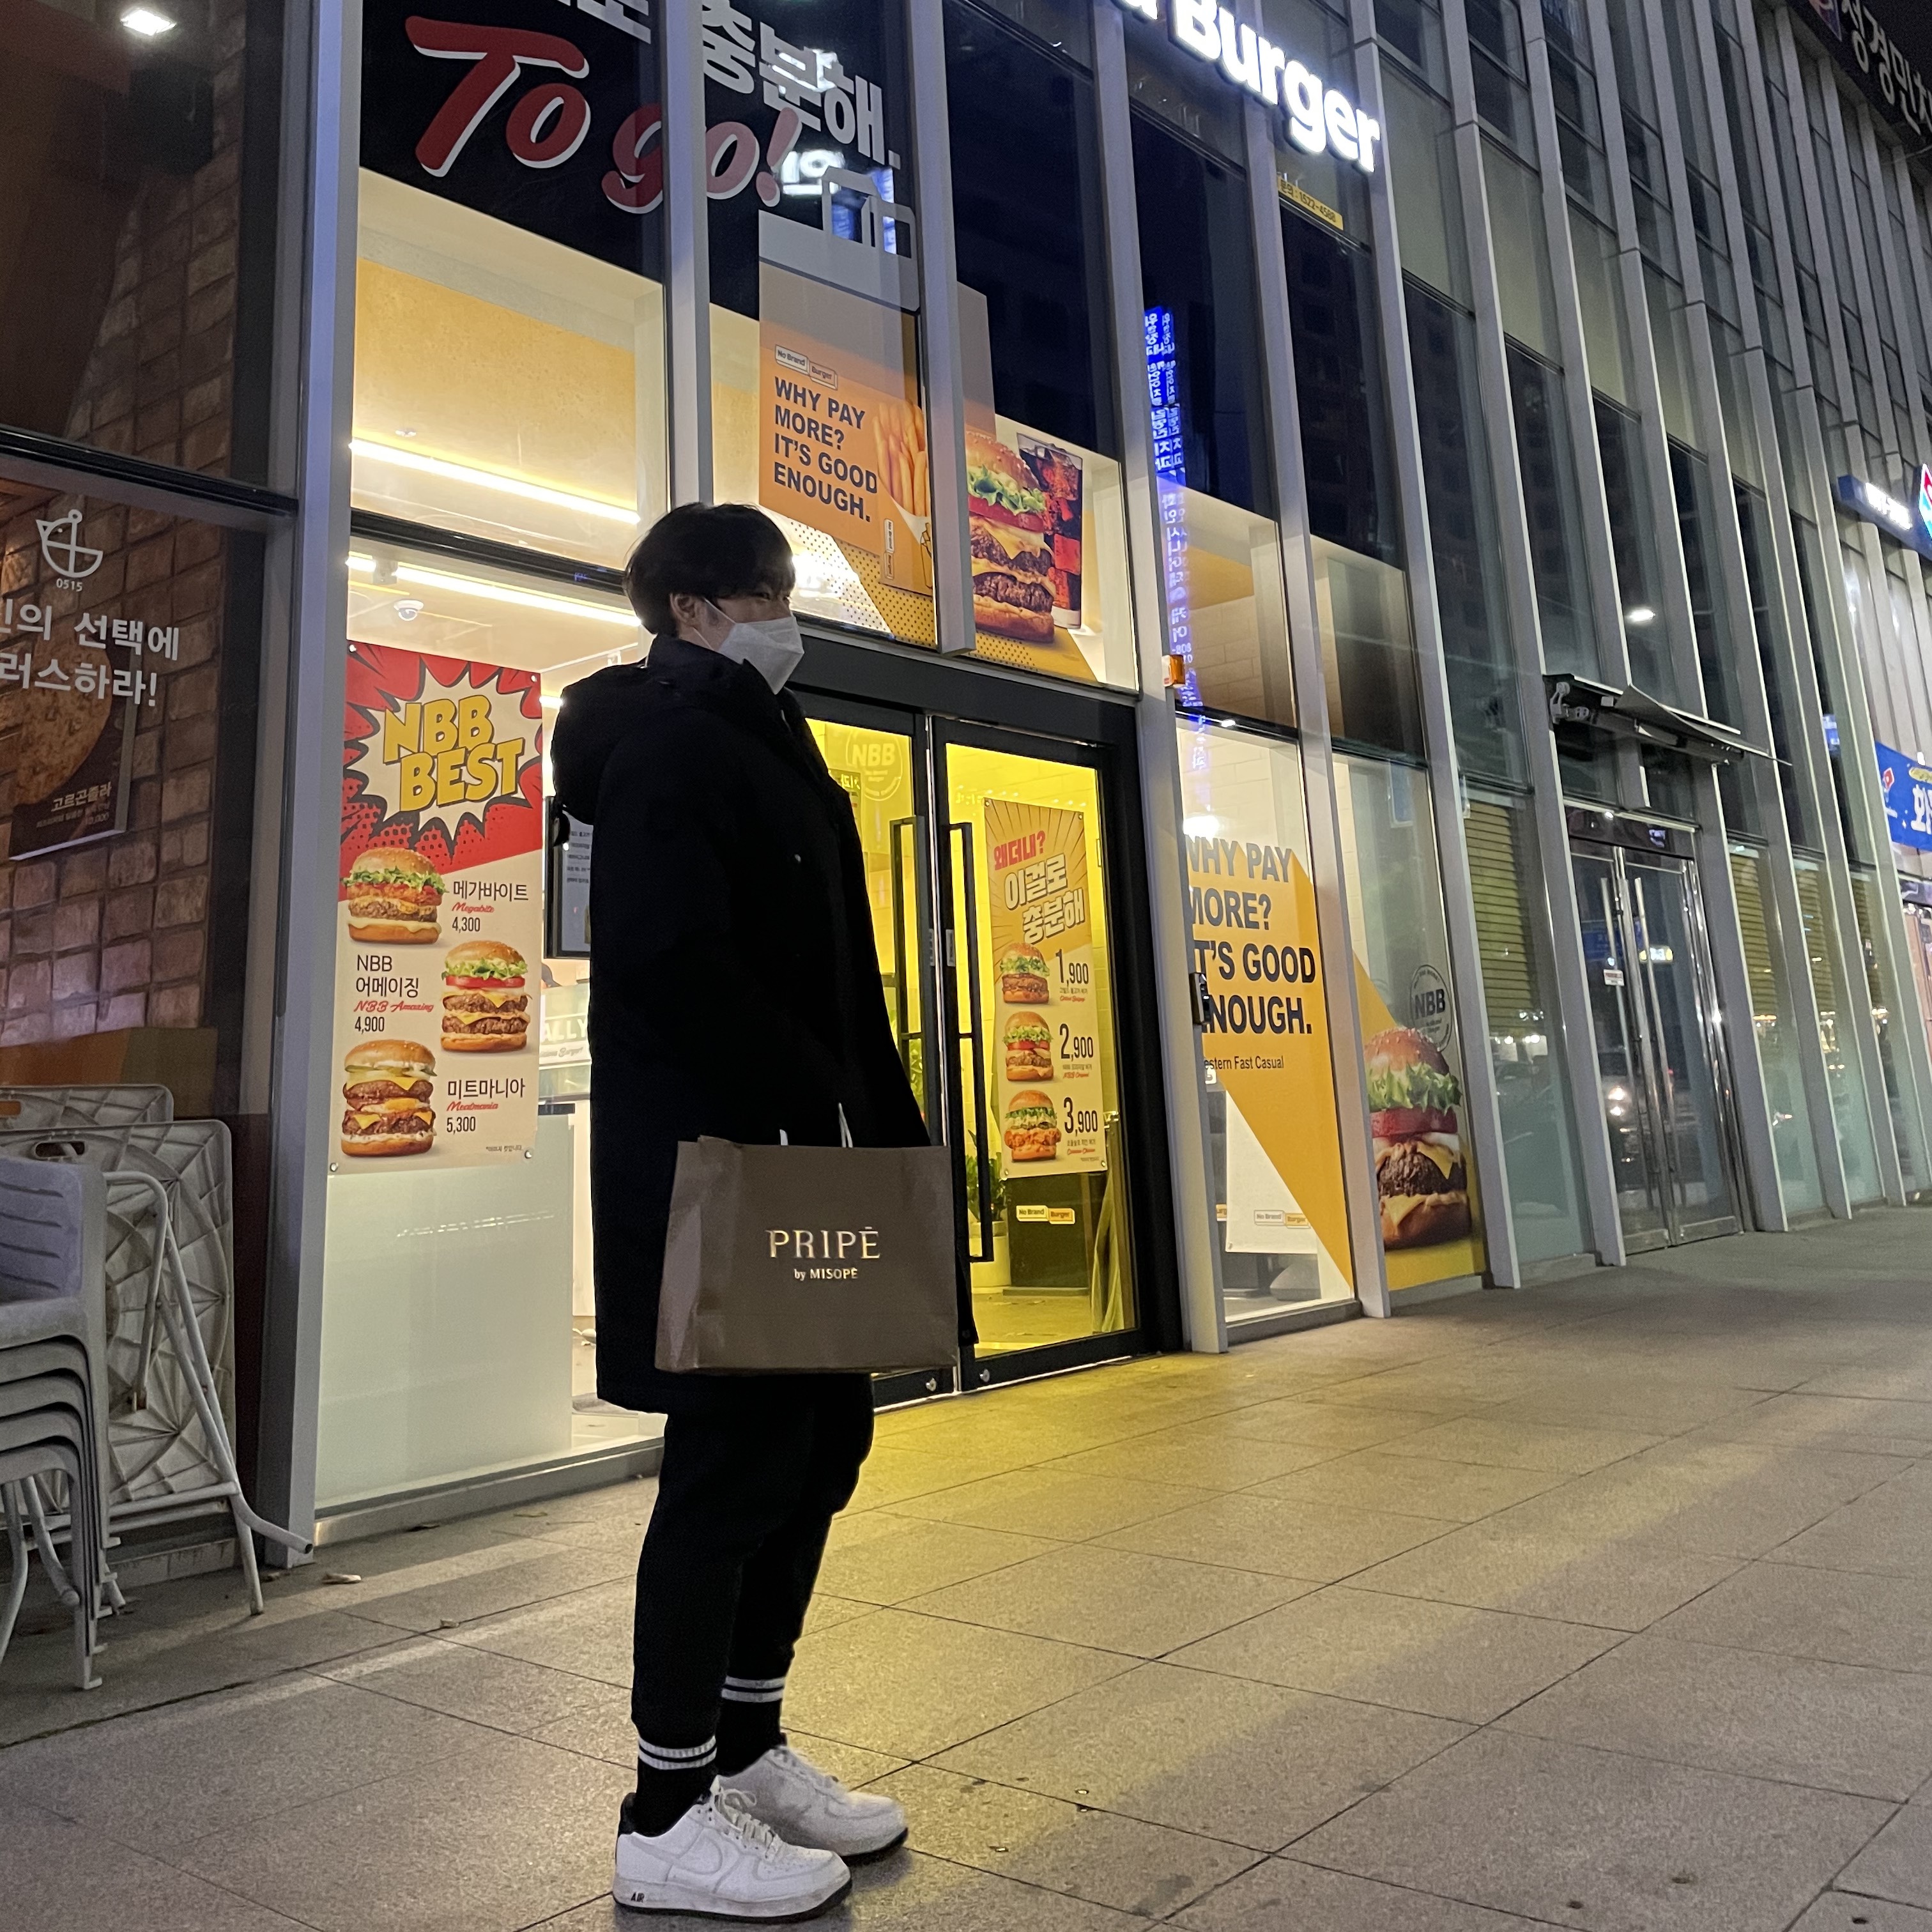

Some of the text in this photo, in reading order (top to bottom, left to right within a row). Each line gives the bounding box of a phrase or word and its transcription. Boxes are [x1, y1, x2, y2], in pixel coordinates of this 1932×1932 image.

[406, 16, 590, 177] To
[1169, 0, 1381, 172] Burger
[787, 353, 805, 366] Brand
[775, 376, 865, 429] WHY PAY
[775, 404, 845, 450] MORE?
[775, 433, 877, 494] IT'S GOOD
[775, 462, 871, 523] ENOUGH.
[56, 578, 82, 592] 0515
[73, 612, 180, 661] 선택에
[383, 694, 495, 765] NBB
[852, 742, 895, 767] NBB
[399, 737, 525, 812] BEST
[1004, 853, 1068, 910] 이걸로
[1246, 843, 1292, 883] PAY
[453, 880, 529, 901] 메가바이트
[452, 916, 480, 933] 4,300
[1023, 887, 1085, 945] 충분해
[357, 954, 392, 972] NBB
[1055, 949, 1089, 986] 1,900
[1194, 940, 1316, 983] T'S GOOD
[356, 976, 419, 998] 어메이징
[1414, 989, 1446, 1020] NBB
[353, 1000, 389, 1013] NBB
[355, 1016, 385, 1034] 4,900
[1202, 995, 1313, 1034] NOUGH.
[1059, 1023, 1094, 1061] 2,900
[1204, 1055, 1284, 1070] estern Fast Casual
[448, 1078, 526, 1100] 미트마니아
[447, 1116, 476, 1135] 5,300
[1063, 1097, 1098, 1137] 3,900
[793, 1268, 806, 1281] by
